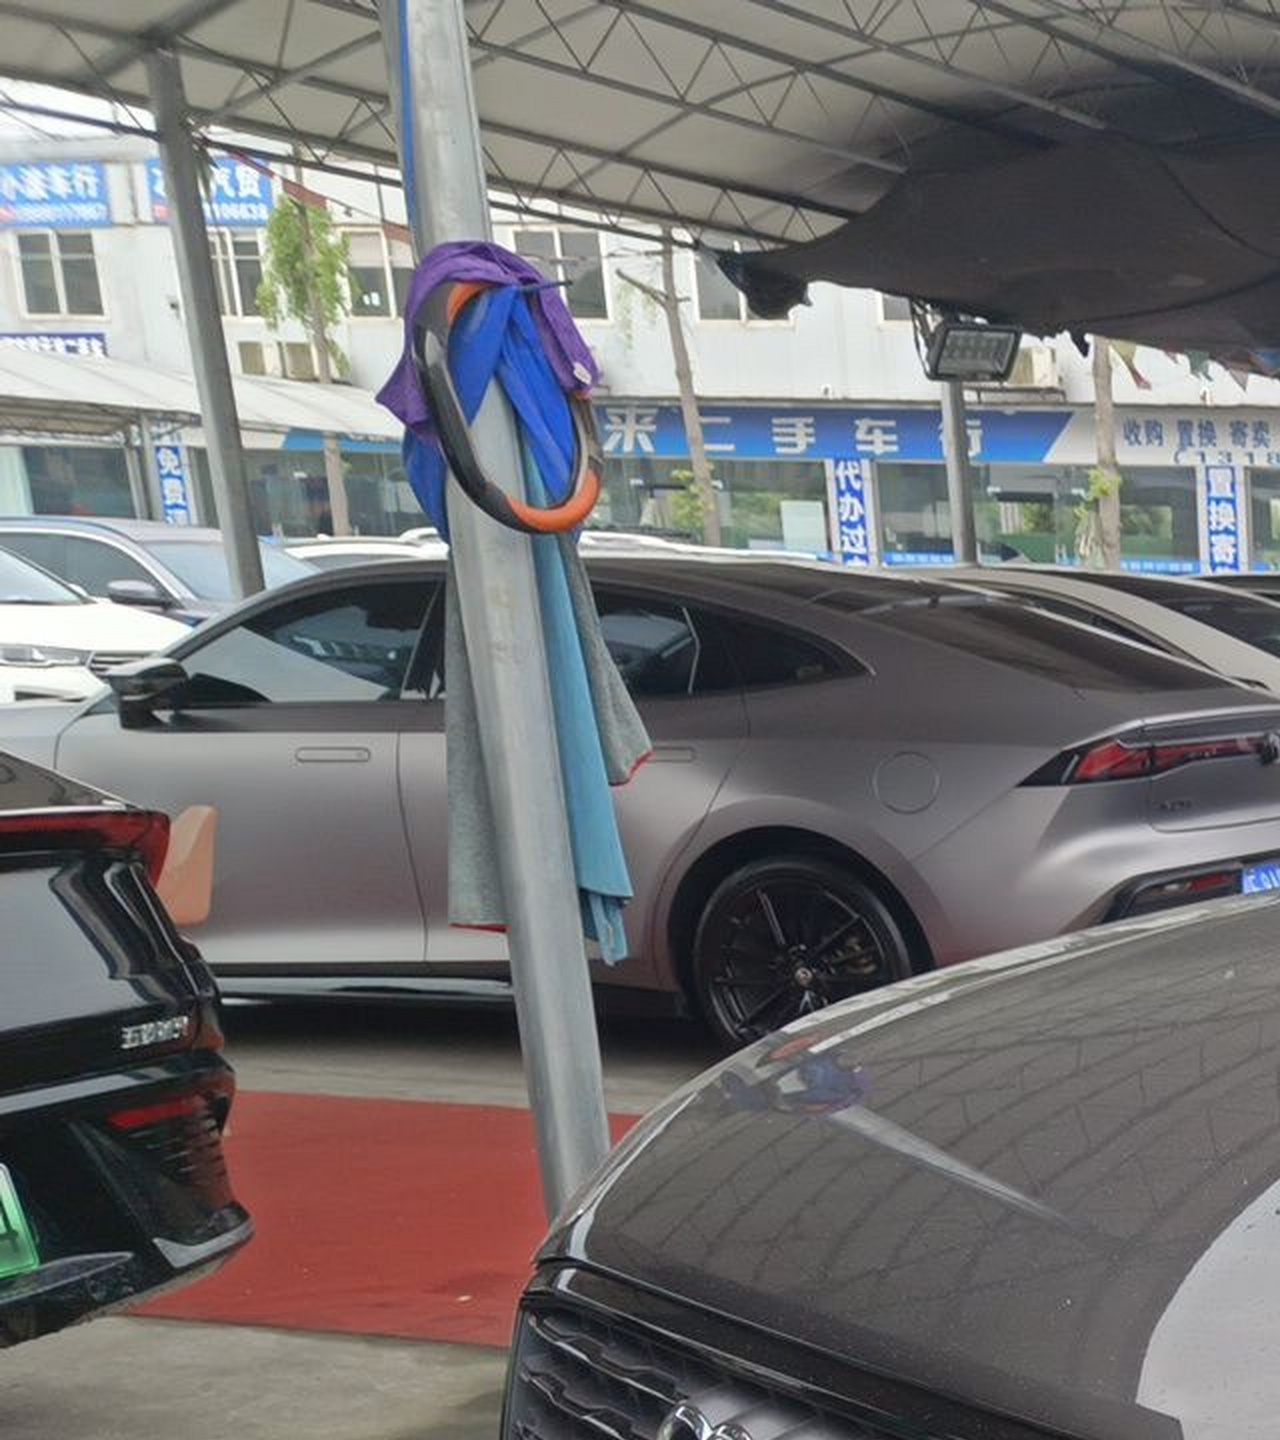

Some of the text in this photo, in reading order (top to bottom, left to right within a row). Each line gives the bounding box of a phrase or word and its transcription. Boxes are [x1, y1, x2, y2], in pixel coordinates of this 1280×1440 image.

[835, 459, 869, 566] 代办过
[1206, 468, 1238, 574] 置换寄
